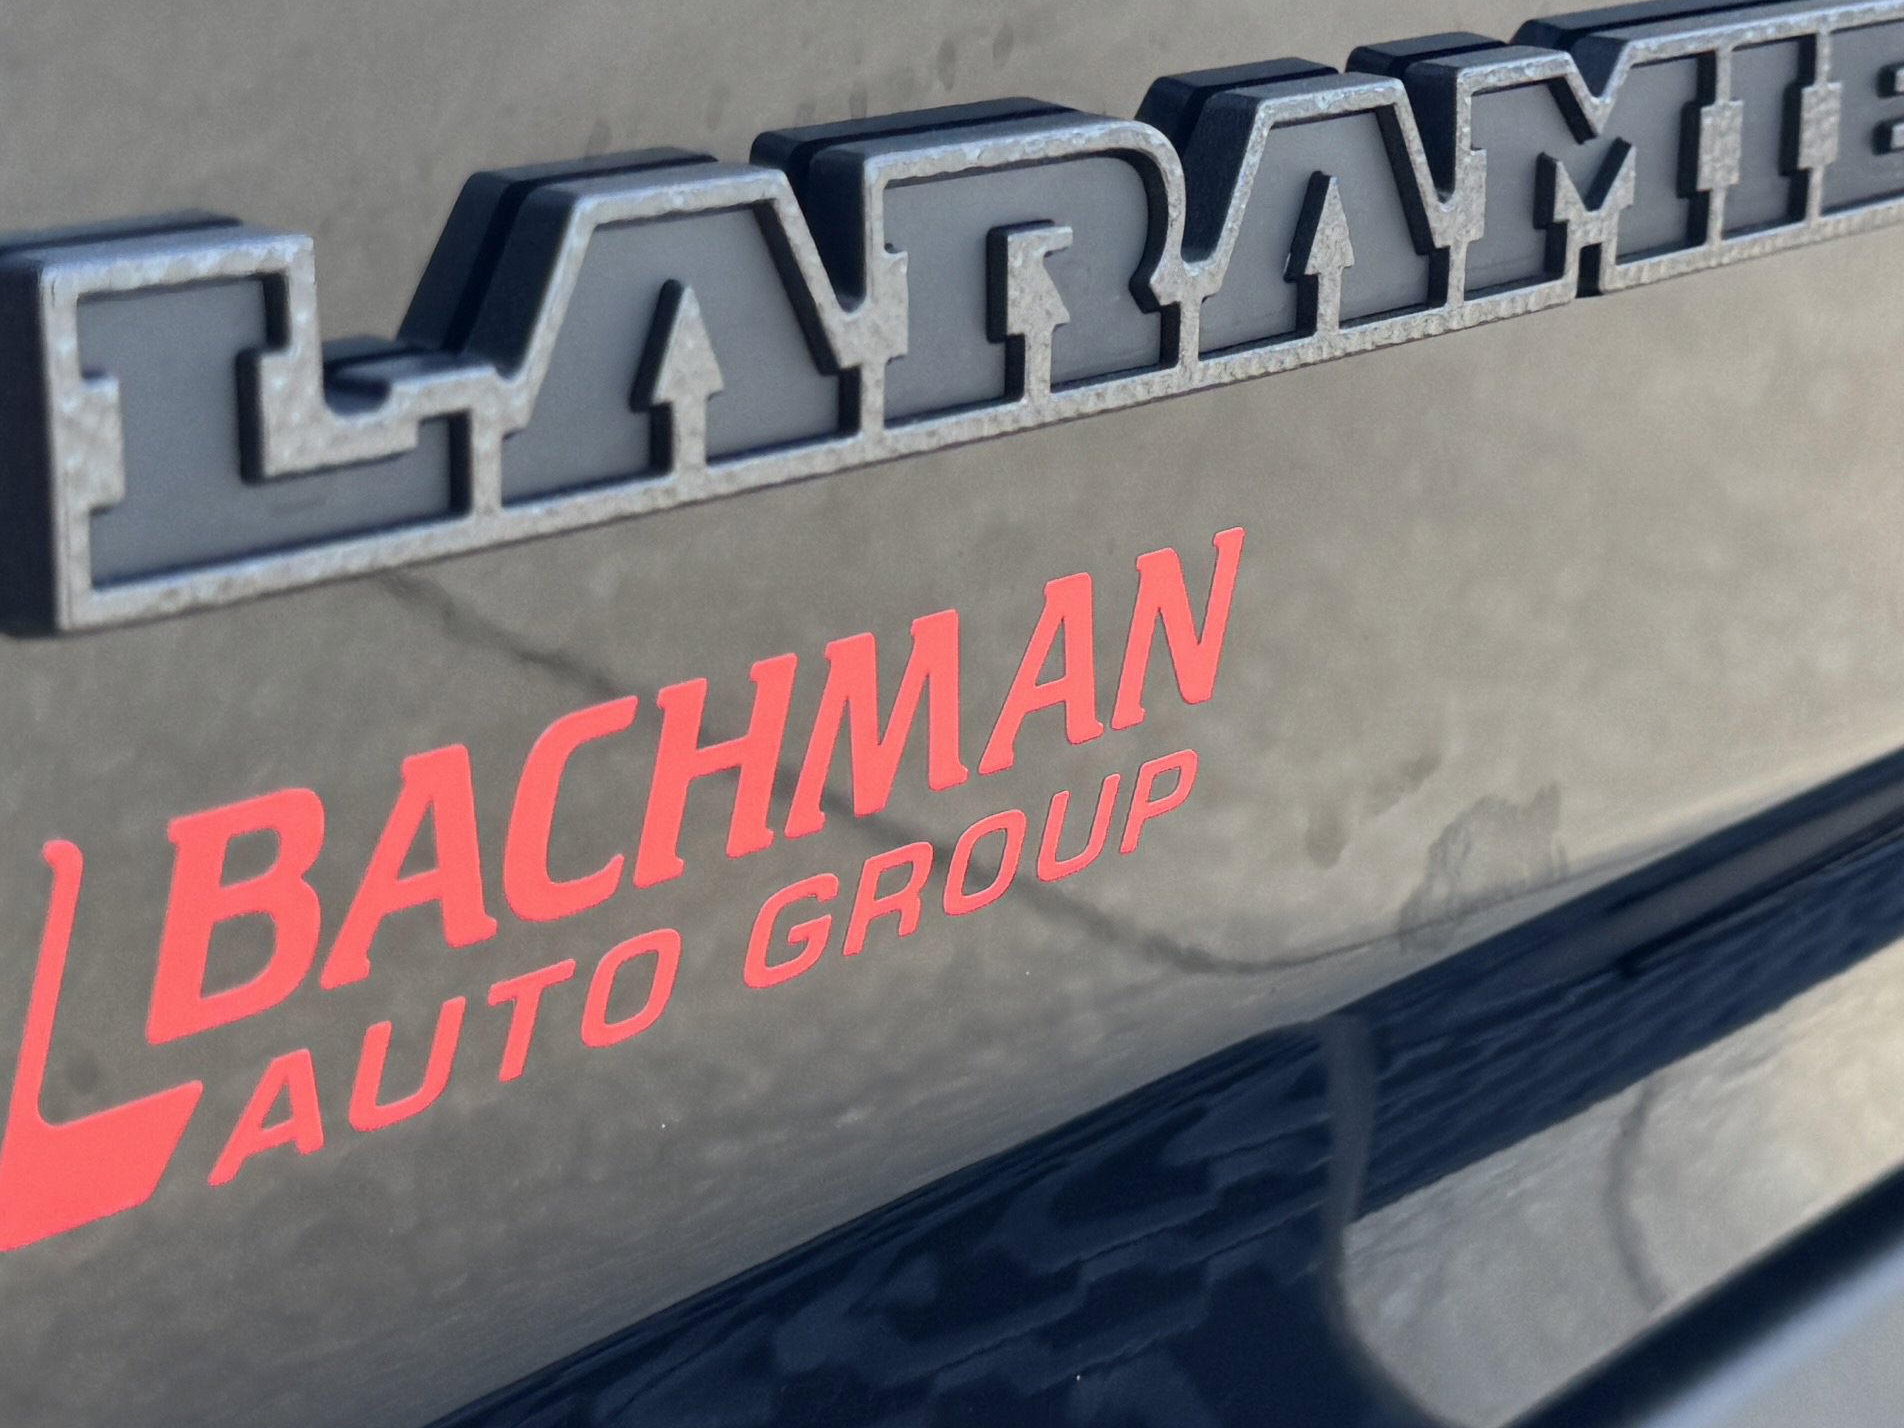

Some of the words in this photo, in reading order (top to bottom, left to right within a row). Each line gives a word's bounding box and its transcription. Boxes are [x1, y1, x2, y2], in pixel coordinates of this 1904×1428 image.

[145, 527, 1246, 1047] BACHMAN
[206, 929, 684, 1189] AUTO
[742, 750, 1199, 990] GROUP
